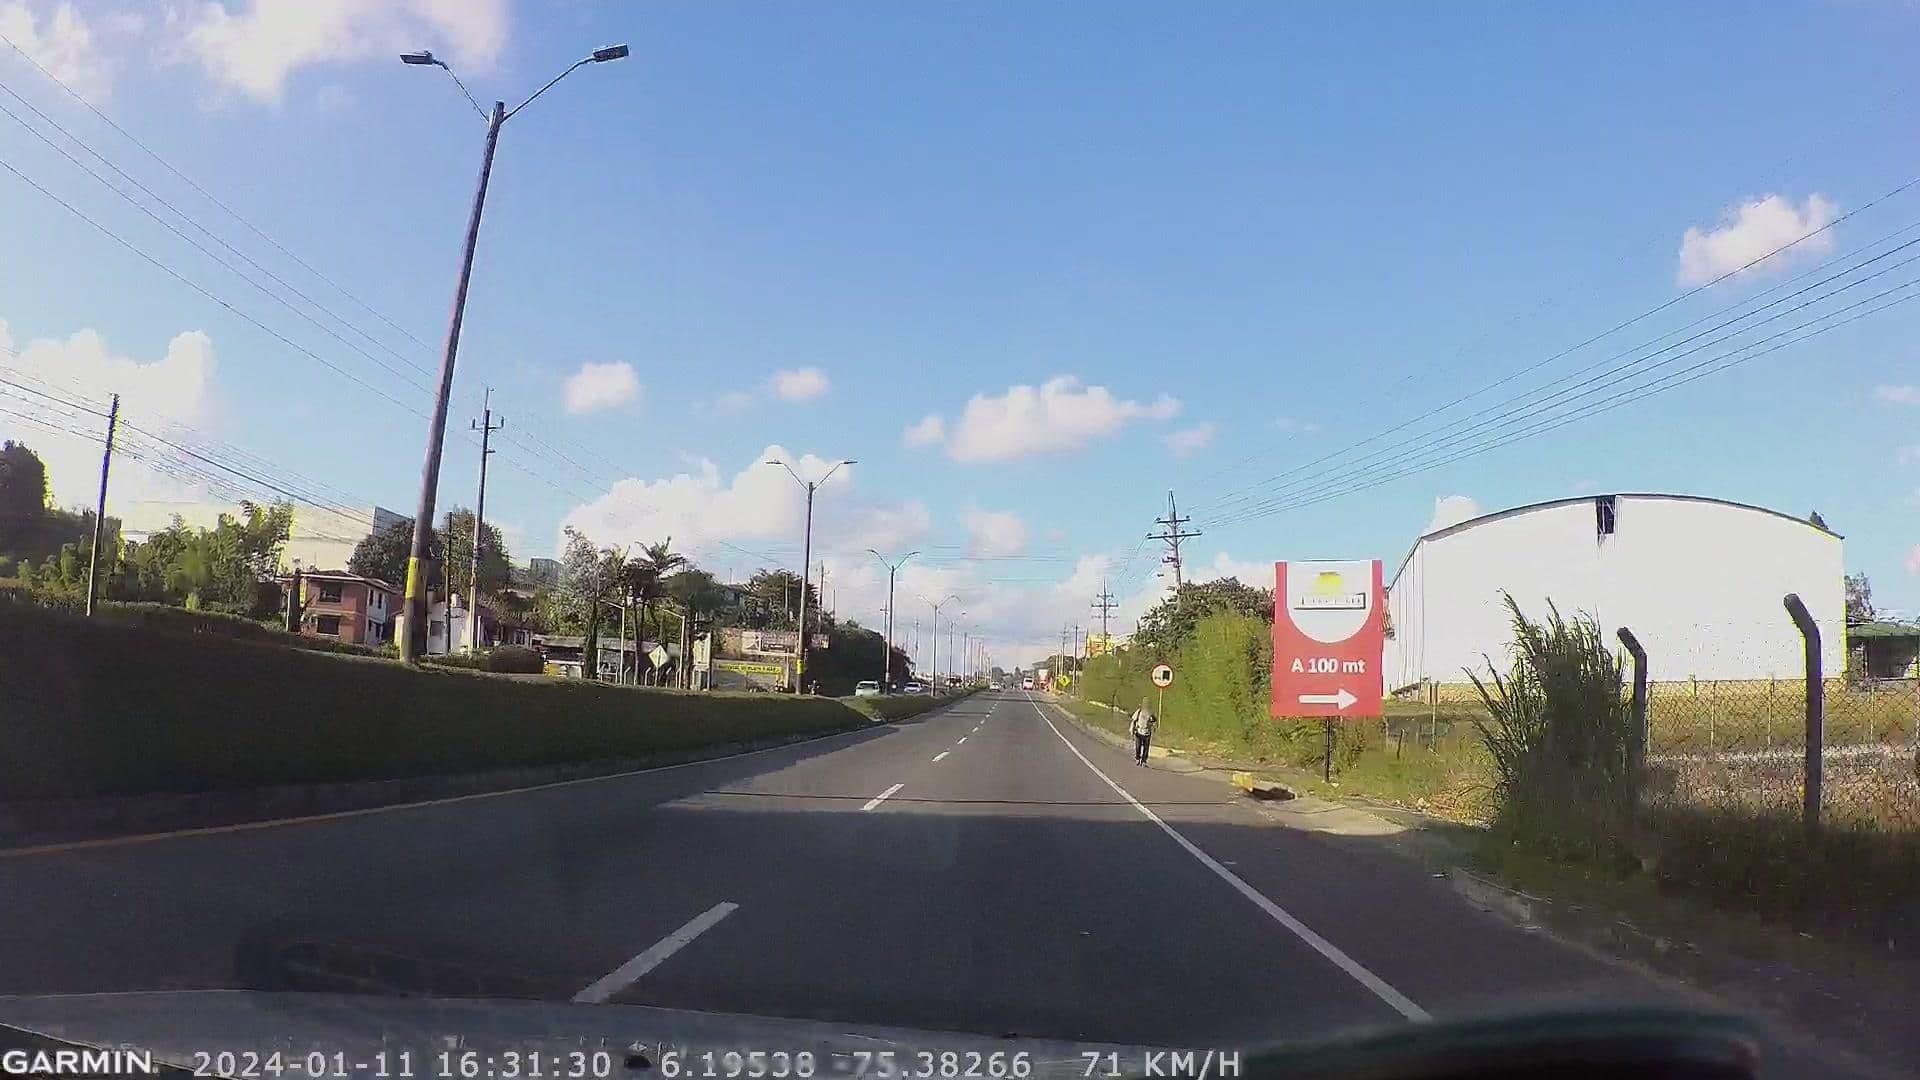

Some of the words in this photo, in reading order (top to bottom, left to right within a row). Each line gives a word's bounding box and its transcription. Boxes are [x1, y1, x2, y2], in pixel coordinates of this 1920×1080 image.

[1291, 657, 1304, 673] A
[1308, 657, 1338, 673] 100
[1342, 659, 1366, 674] mt
